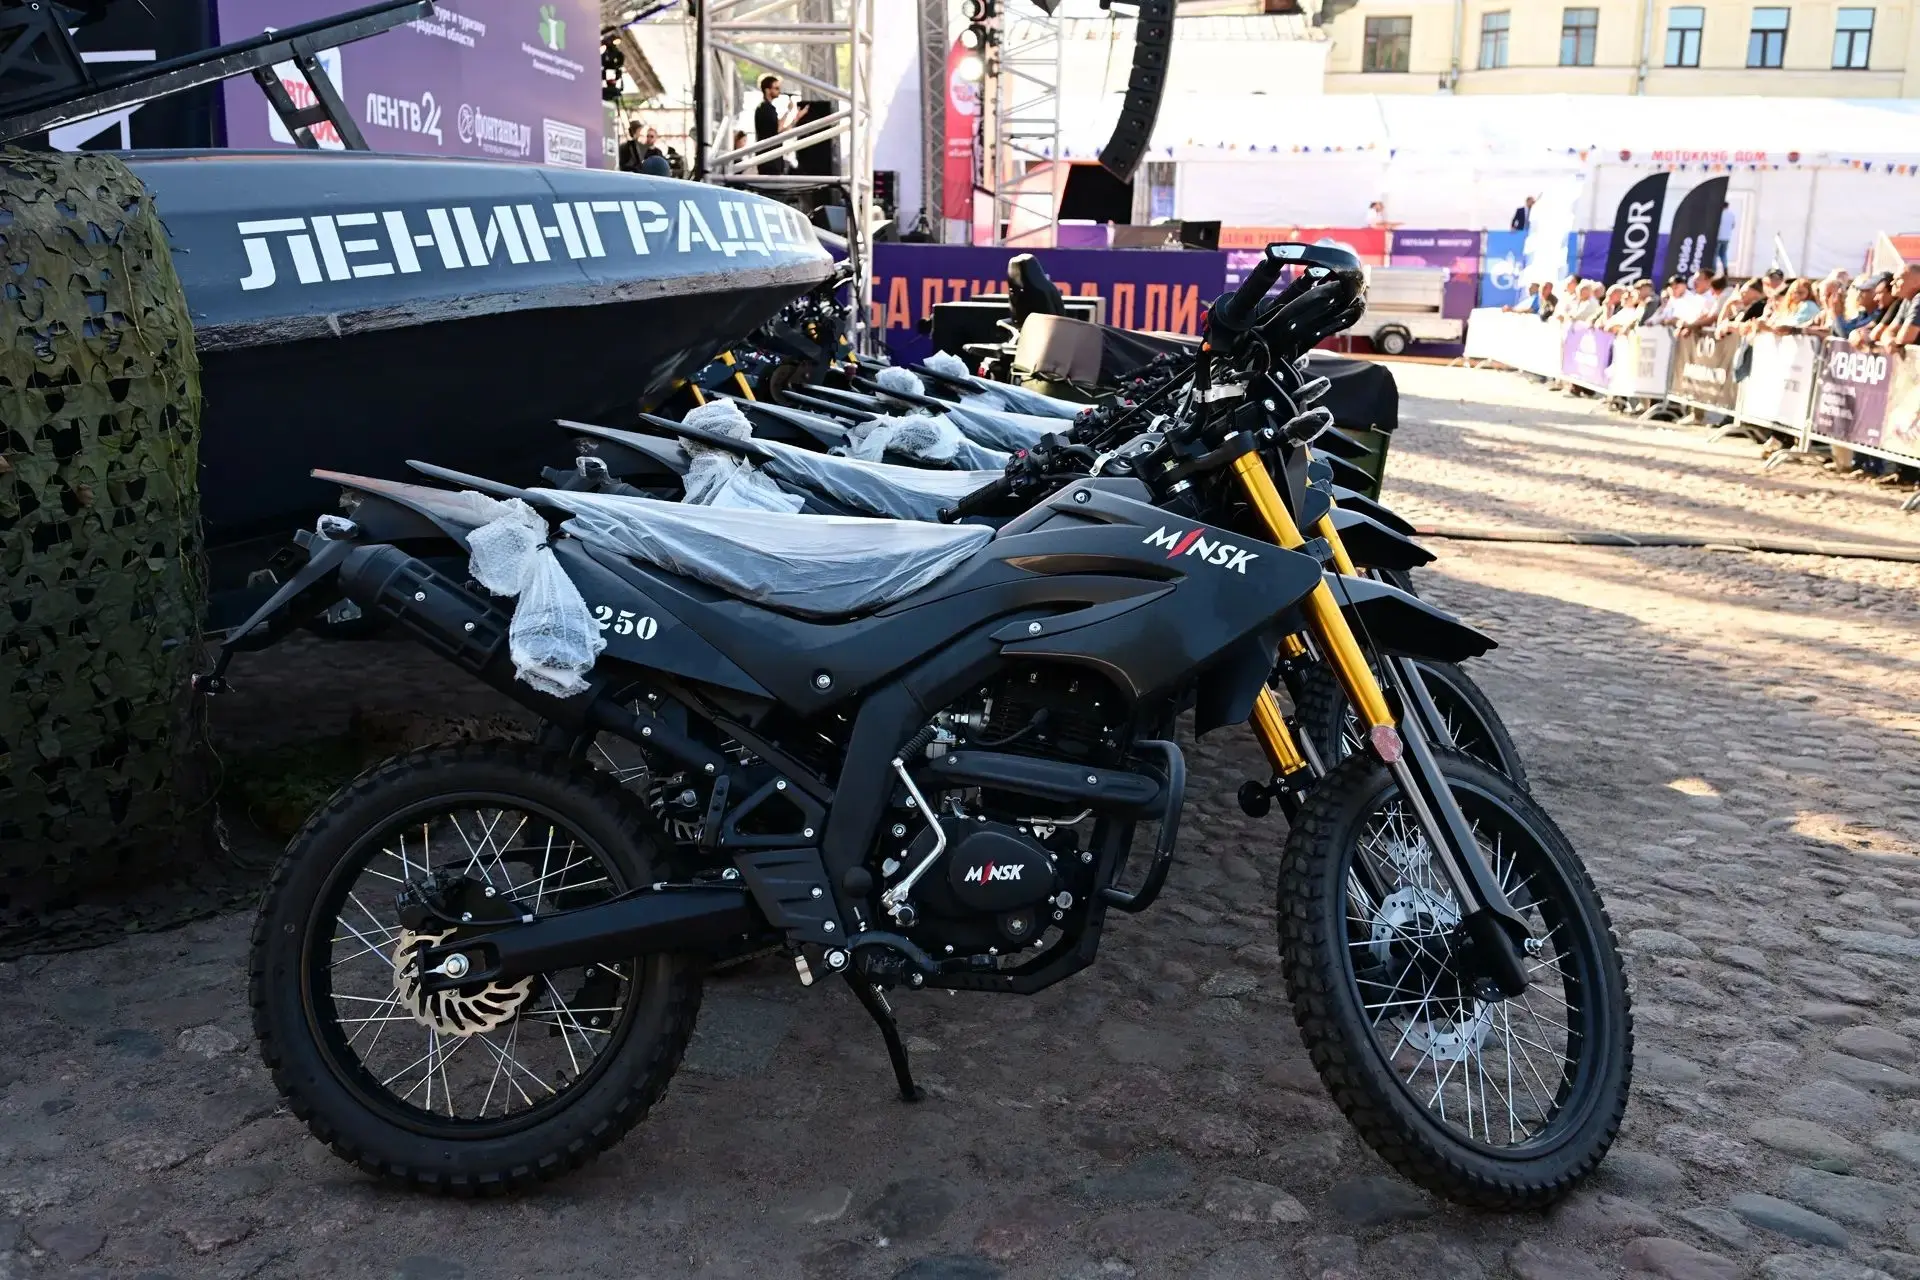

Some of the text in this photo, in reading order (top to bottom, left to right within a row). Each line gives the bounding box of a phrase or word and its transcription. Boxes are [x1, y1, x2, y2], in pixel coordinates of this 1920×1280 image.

[237, 200, 806, 291] ЛЕНИНГРАДЕЦ
[1142, 526, 1260, 574] MINSK
[595, 605, 658, 640] 250
[964, 861, 1024, 886] MINSK
